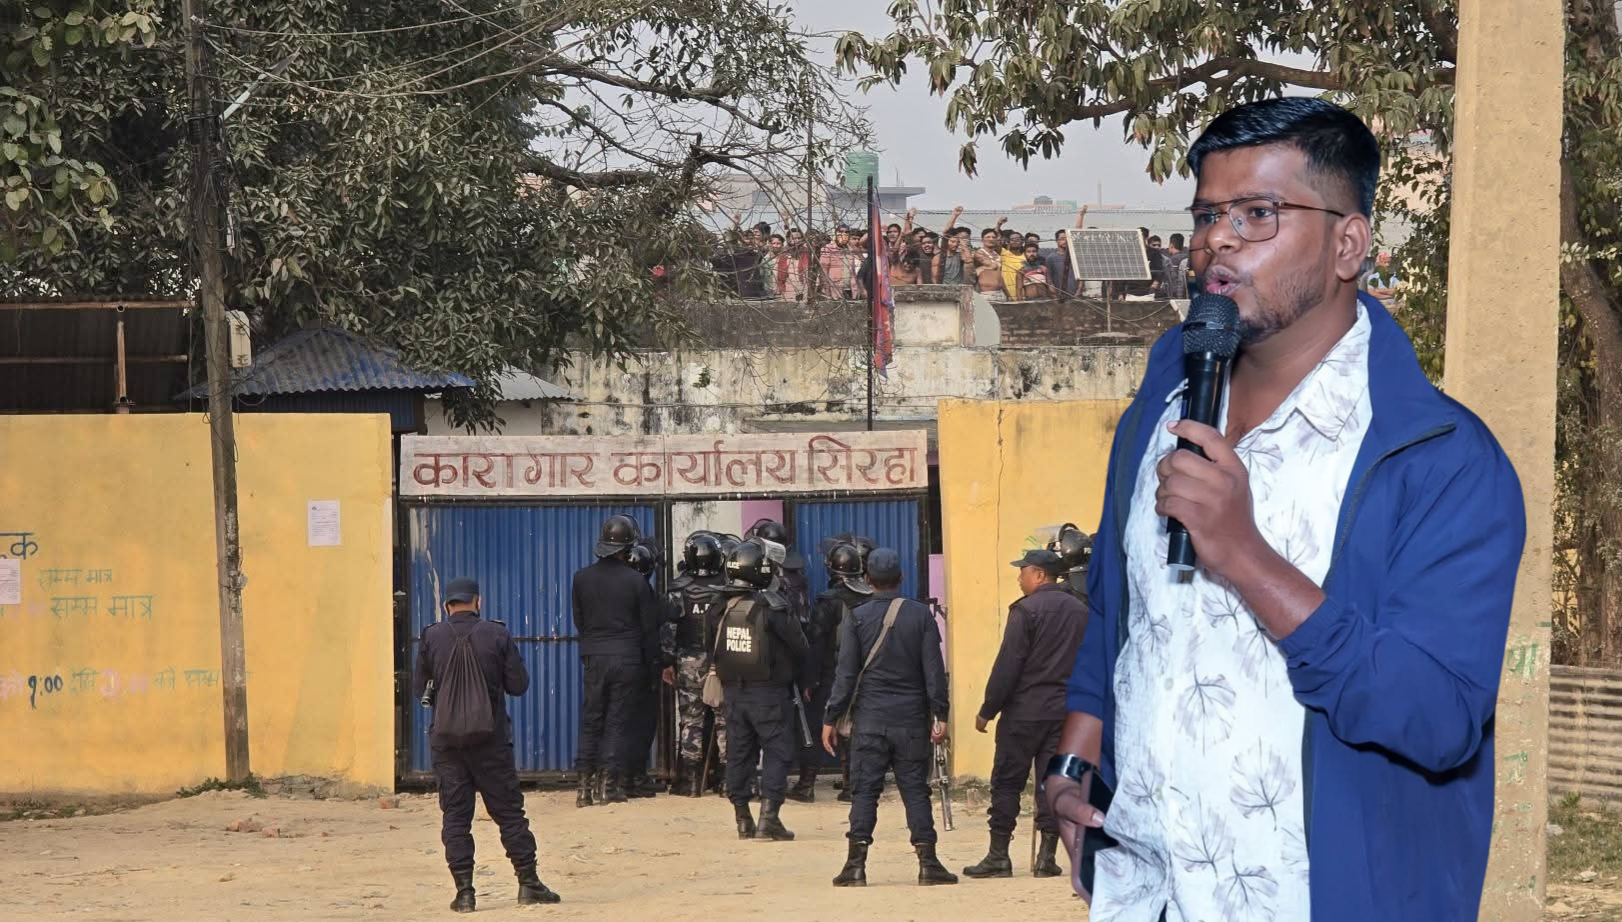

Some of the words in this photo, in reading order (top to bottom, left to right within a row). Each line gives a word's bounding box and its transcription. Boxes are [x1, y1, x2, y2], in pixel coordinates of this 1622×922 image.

[413, 452, 600, 489] कारागार
[611, 440, 798, 487] कार्यालय
[803, 435, 917, 485] सिरहा
[108, 595, 152, 621] मात्र
[726, 626, 752, 640] NEPAL
[726, 639, 752, 653] POLICE
